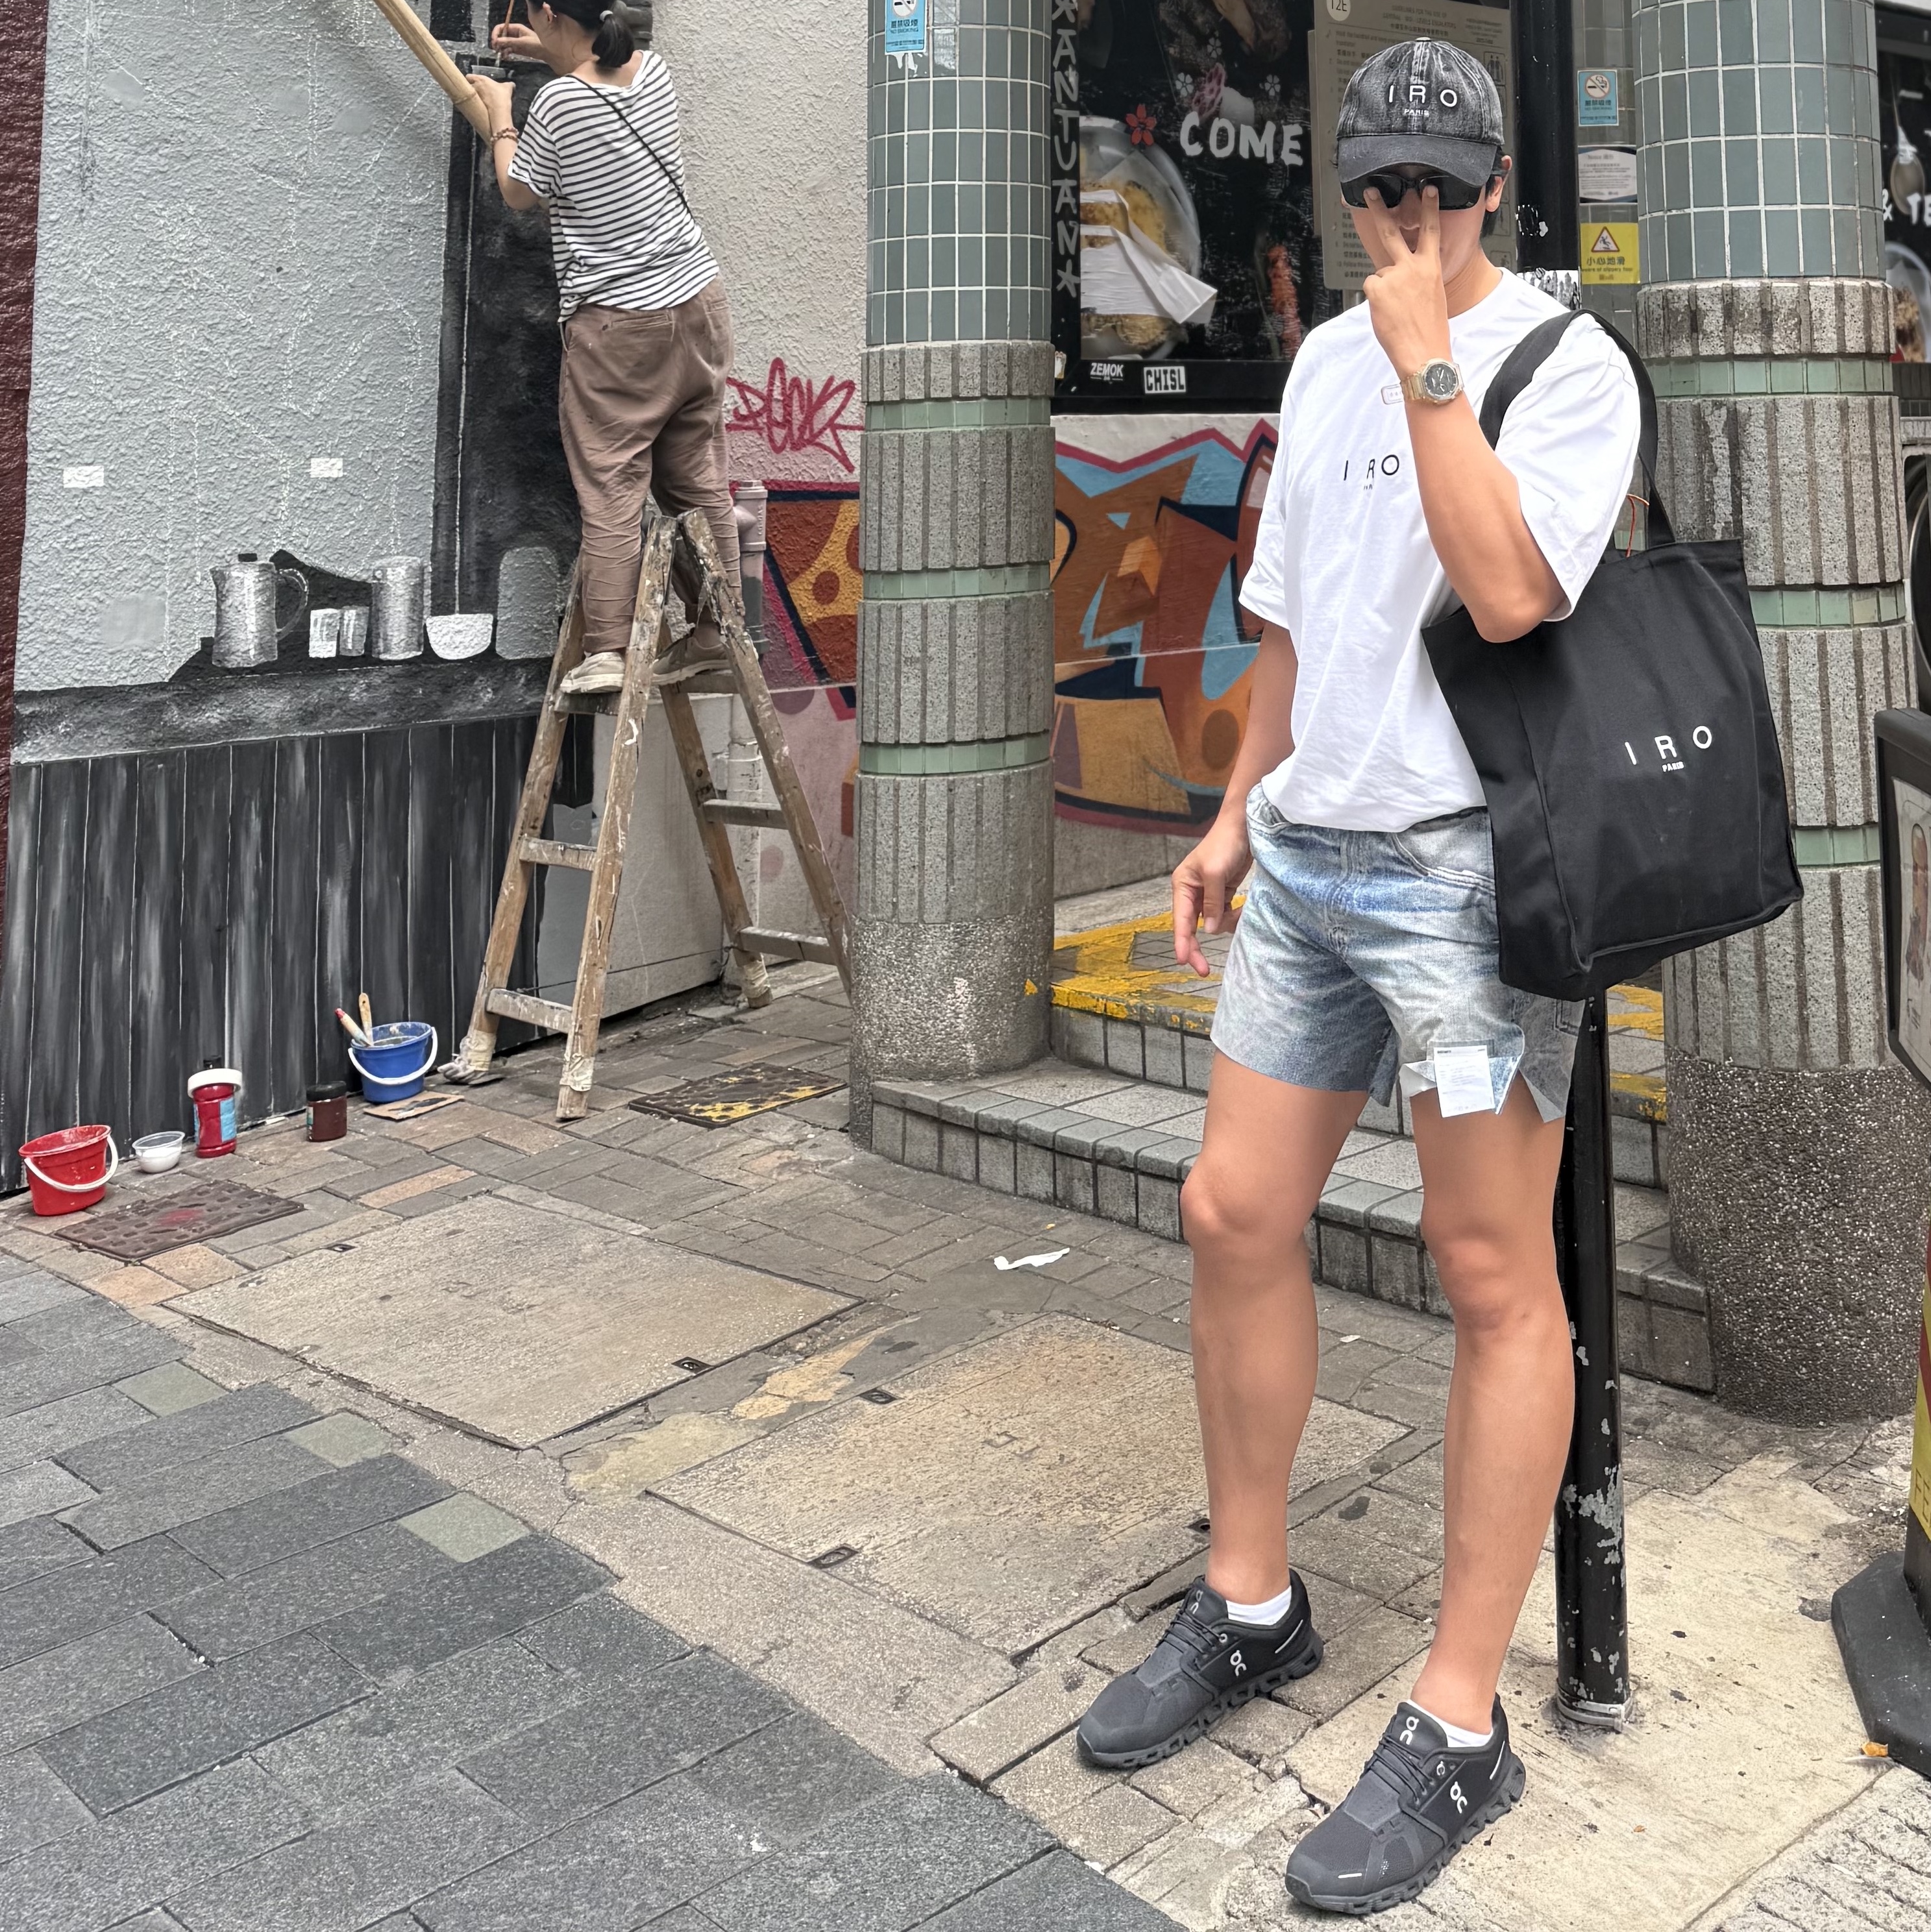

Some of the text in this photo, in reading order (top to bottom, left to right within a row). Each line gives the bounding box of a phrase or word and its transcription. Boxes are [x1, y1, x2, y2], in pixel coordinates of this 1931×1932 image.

[1180, 111, 1303, 166] COME
[1090, 362, 1124, 378] ZEMOK
[1146, 368, 1185, 391] CHISL
